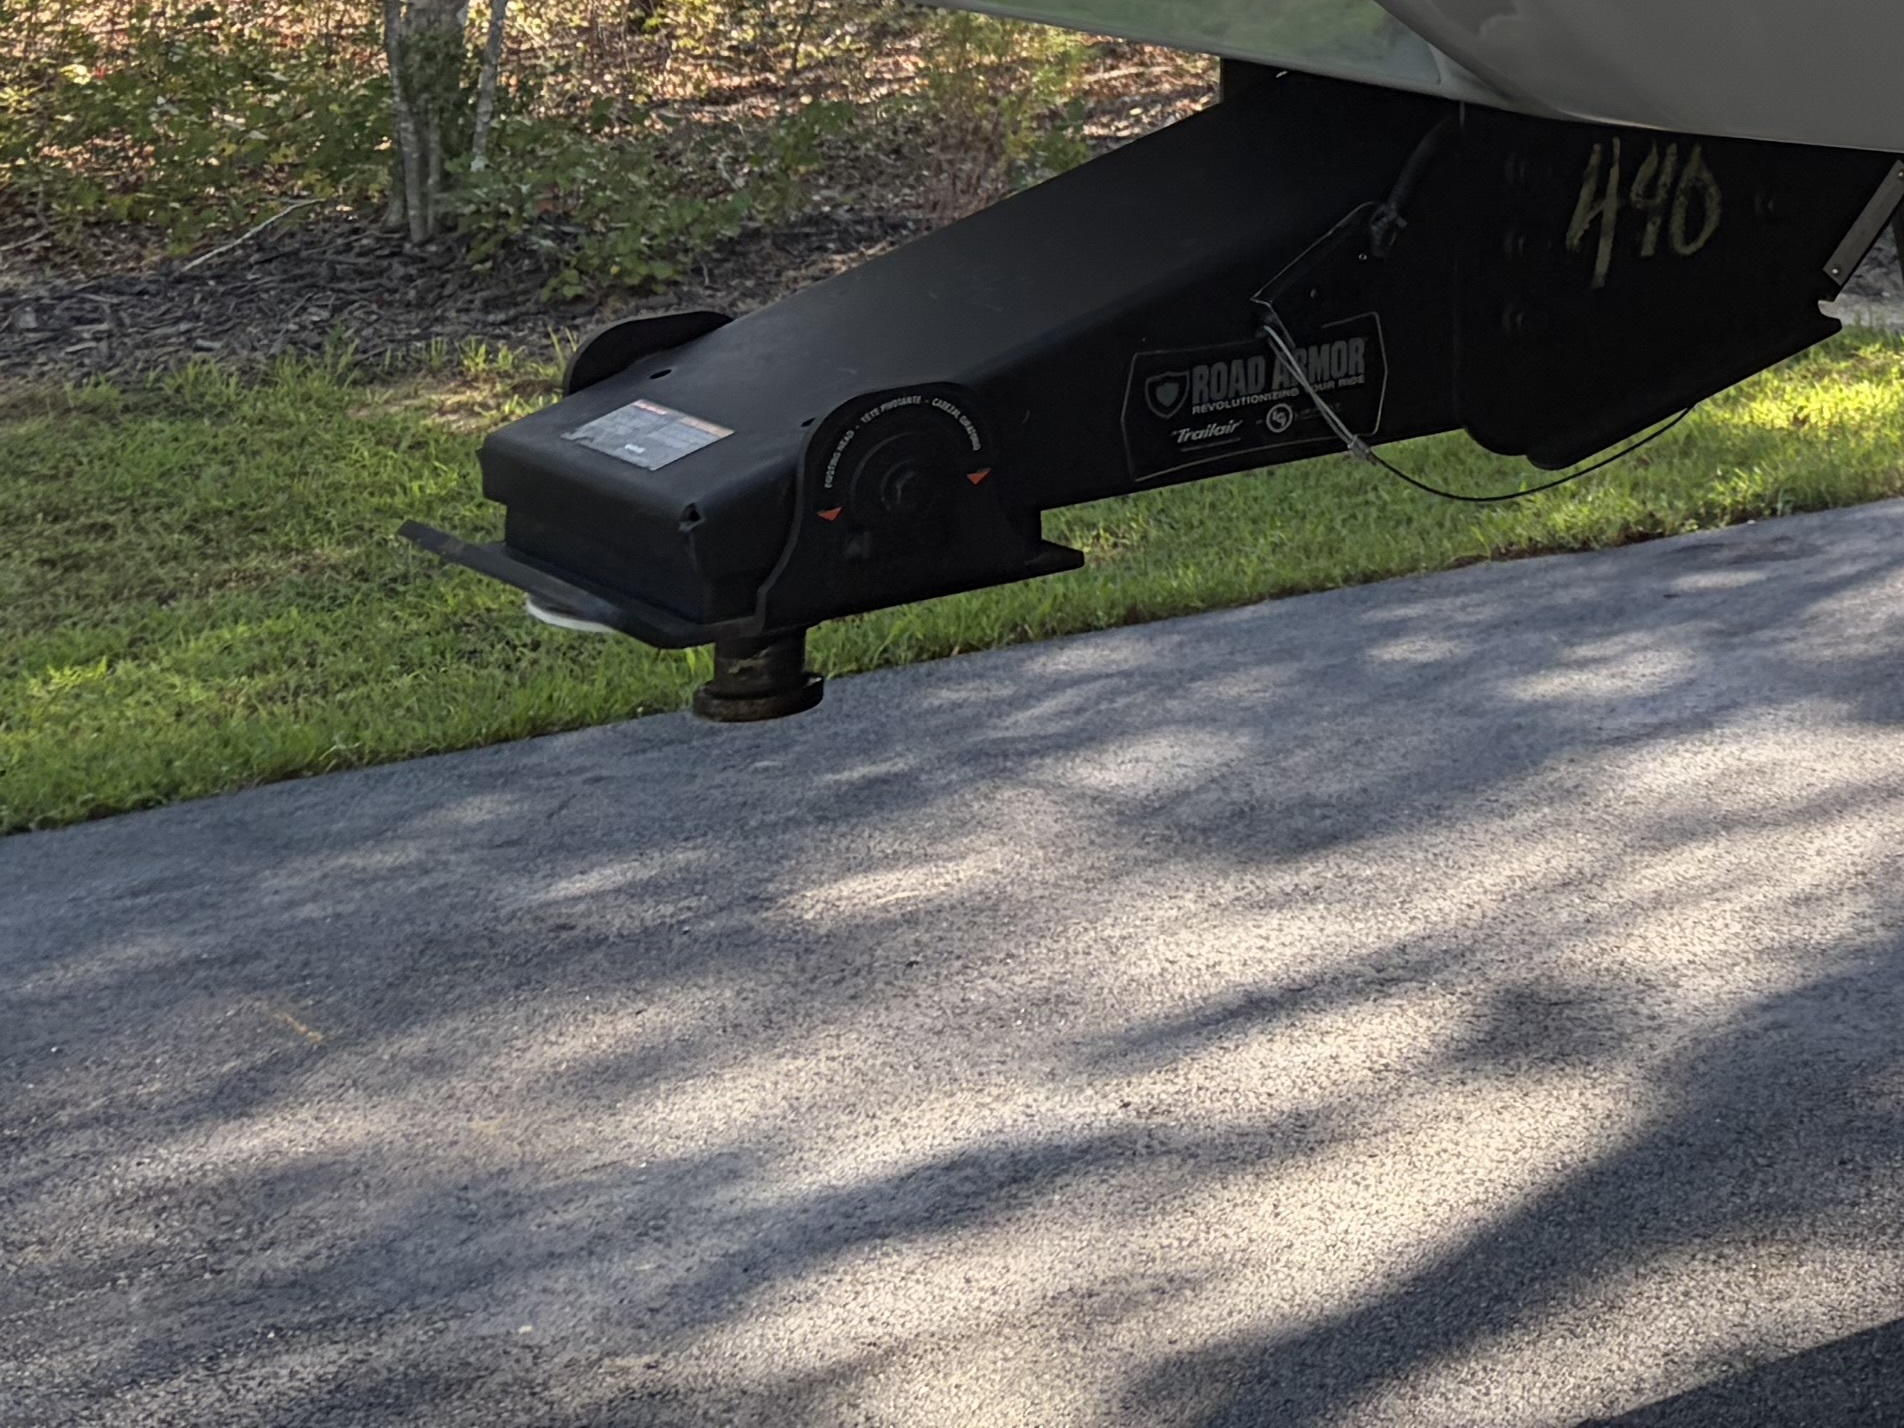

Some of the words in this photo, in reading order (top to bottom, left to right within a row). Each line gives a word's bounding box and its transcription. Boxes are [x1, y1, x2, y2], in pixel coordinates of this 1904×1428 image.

[1192, 355, 1265, 405] ROAD
[1192, 387, 1299, 415] REVOLUTIONIZING
[1171, 419, 1244, 444] Trailair
